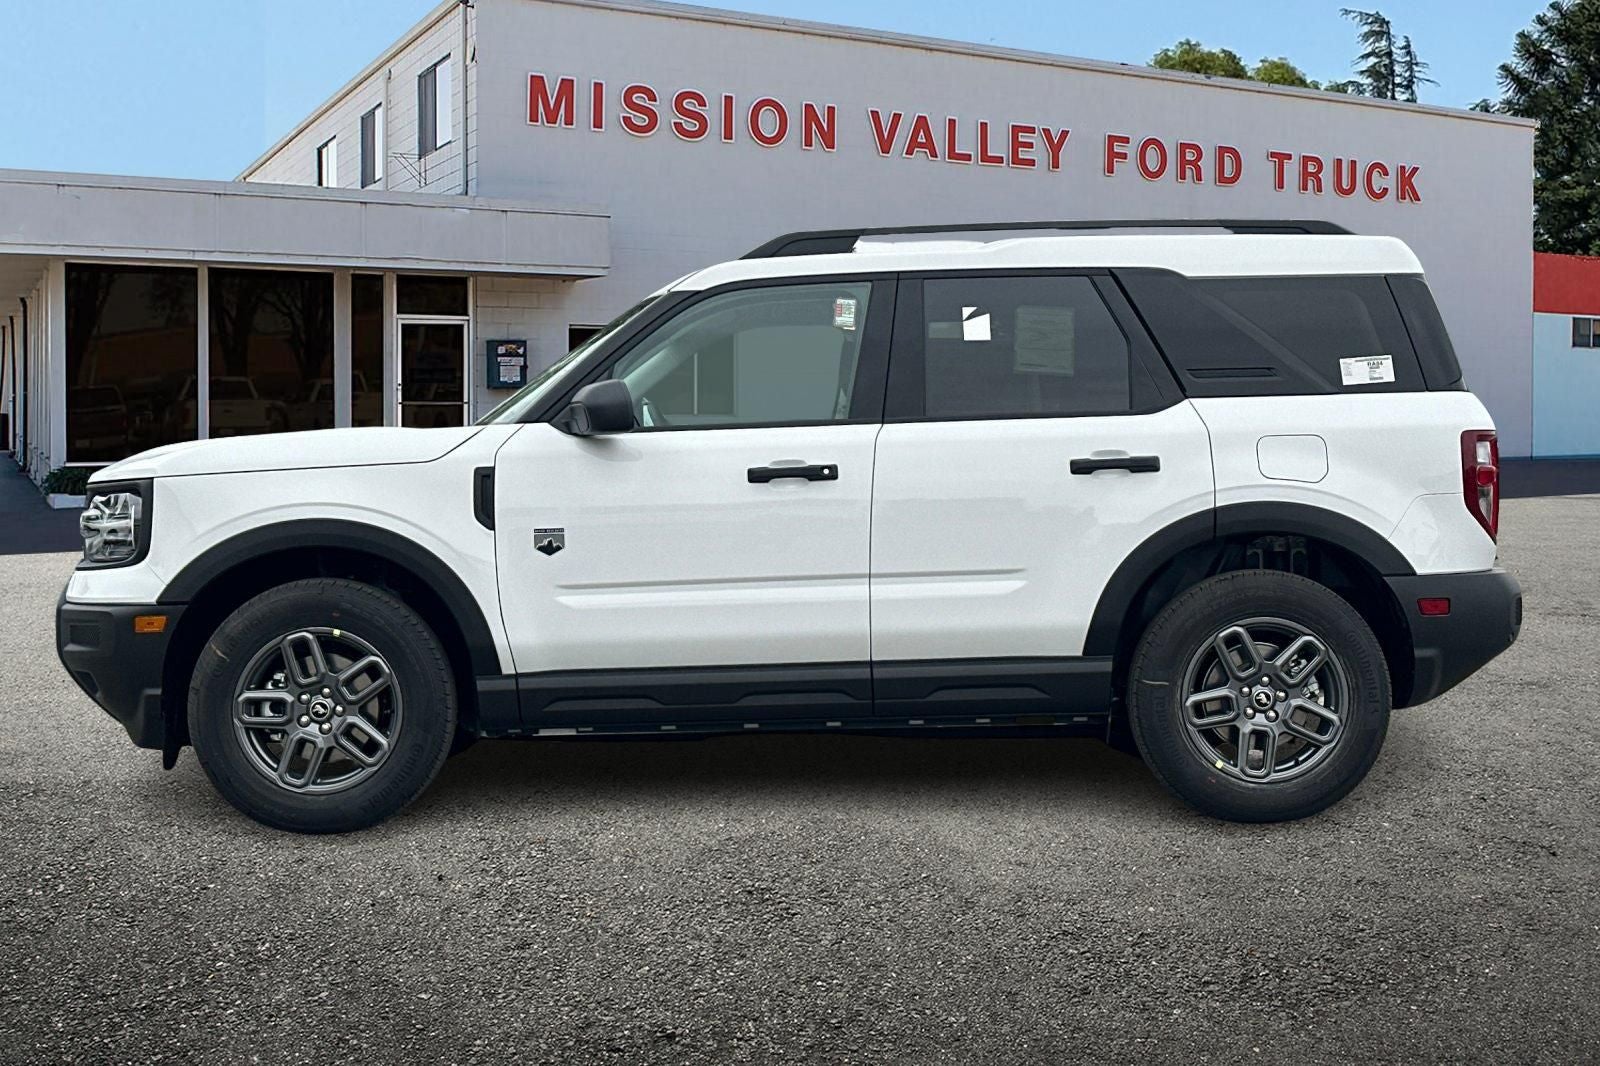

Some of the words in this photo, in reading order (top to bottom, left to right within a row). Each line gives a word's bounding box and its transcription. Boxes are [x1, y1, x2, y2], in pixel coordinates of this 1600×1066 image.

[527, 72, 837, 152] MISSION
[868, 107, 1071, 171] VALLEY
[1104, 132, 1243, 187] FORD
[1267, 149, 1422, 203] TRUCK
